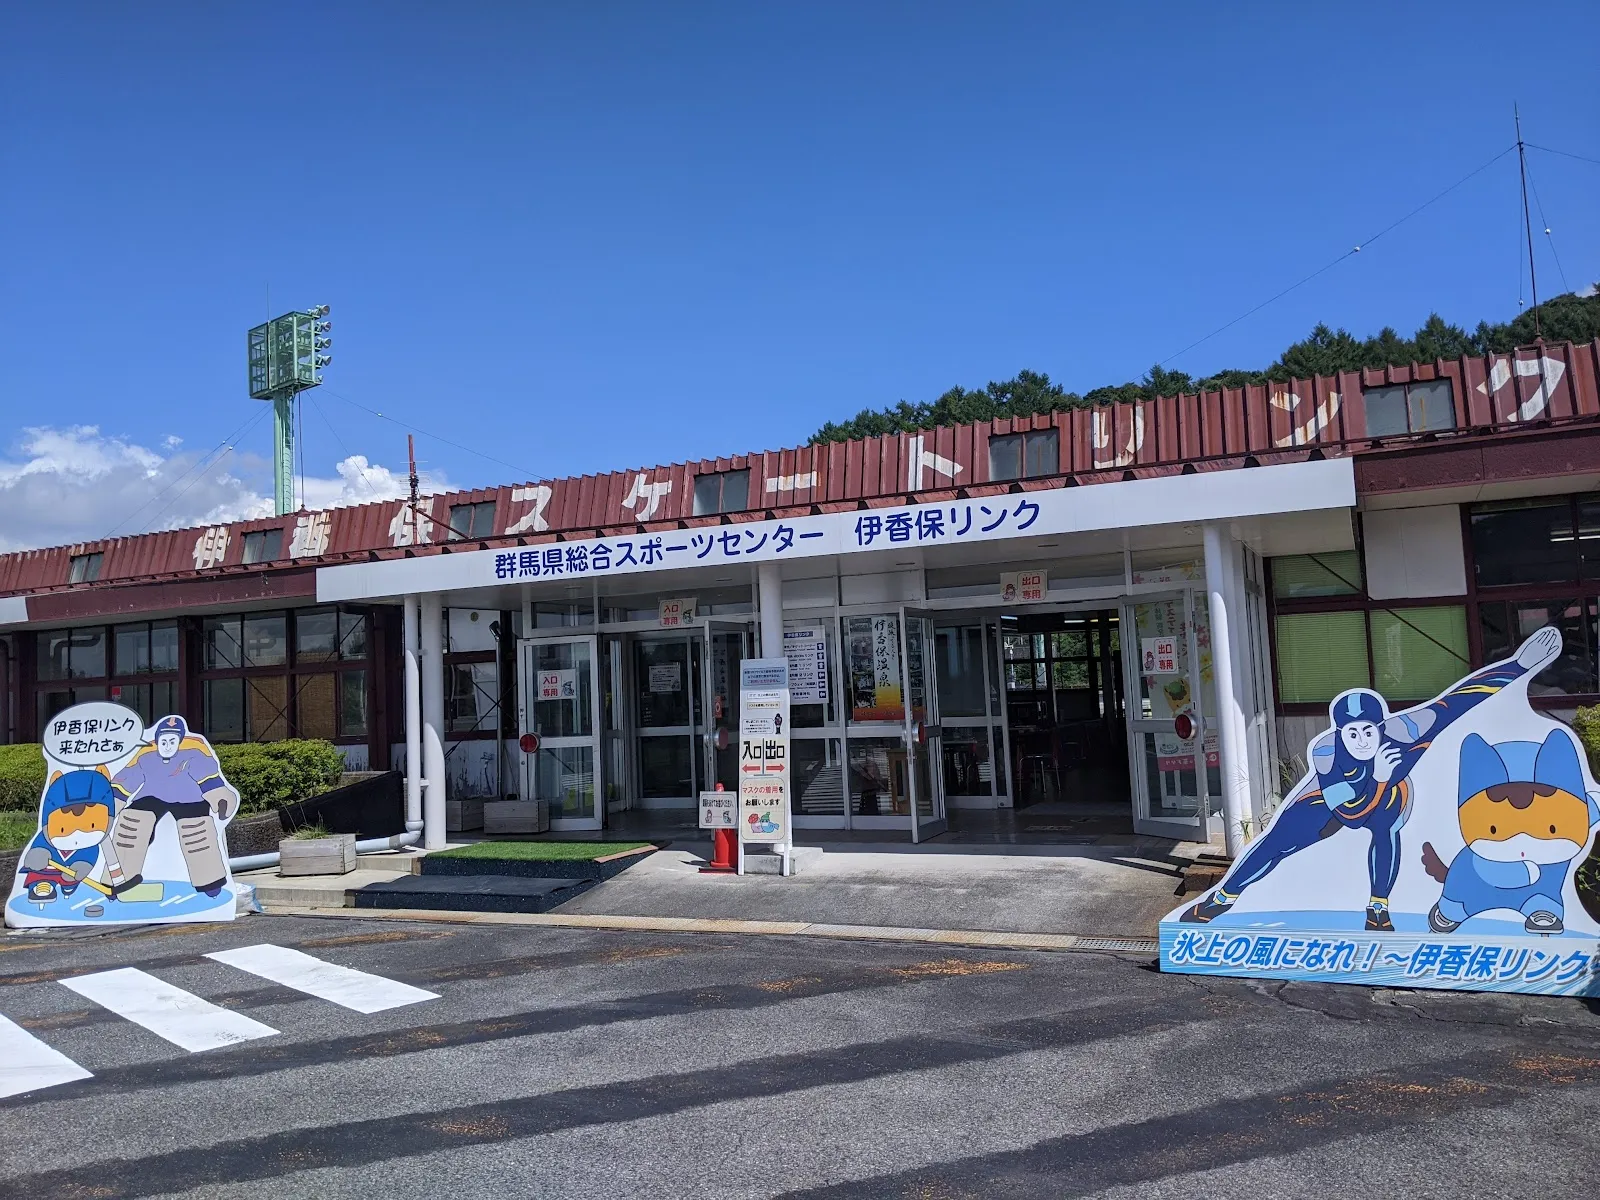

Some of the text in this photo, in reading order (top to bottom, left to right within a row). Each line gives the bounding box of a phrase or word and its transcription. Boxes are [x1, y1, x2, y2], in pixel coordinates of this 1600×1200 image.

[494, 500, 1041, 579] 群馬県総合スポーツセンター 伊香保リンク
[1022, 576, 1040, 586] 出口
[1022, 590, 1041, 600] 専用
[664, 604, 679, 613] 入口
[663, 616, 678, 625] 専用
[874, 619, 891, 687] 伊香保温泉
[1158, 643, 1172, 655] 出口
[1158, 659, 1174, 670] 専用
[543, 676, 558, 685] 入口
[543, 688, 558, 697] 専用
[53, 717, 135, 736] 伊香保リンク
[59, 738, 124, 755] 来たんさぁ
[742, 739, 785, 760] 入口 出口
[742, 786, 784, 794] マスクの着用を
[745, 798, 780, 807] お願いします
